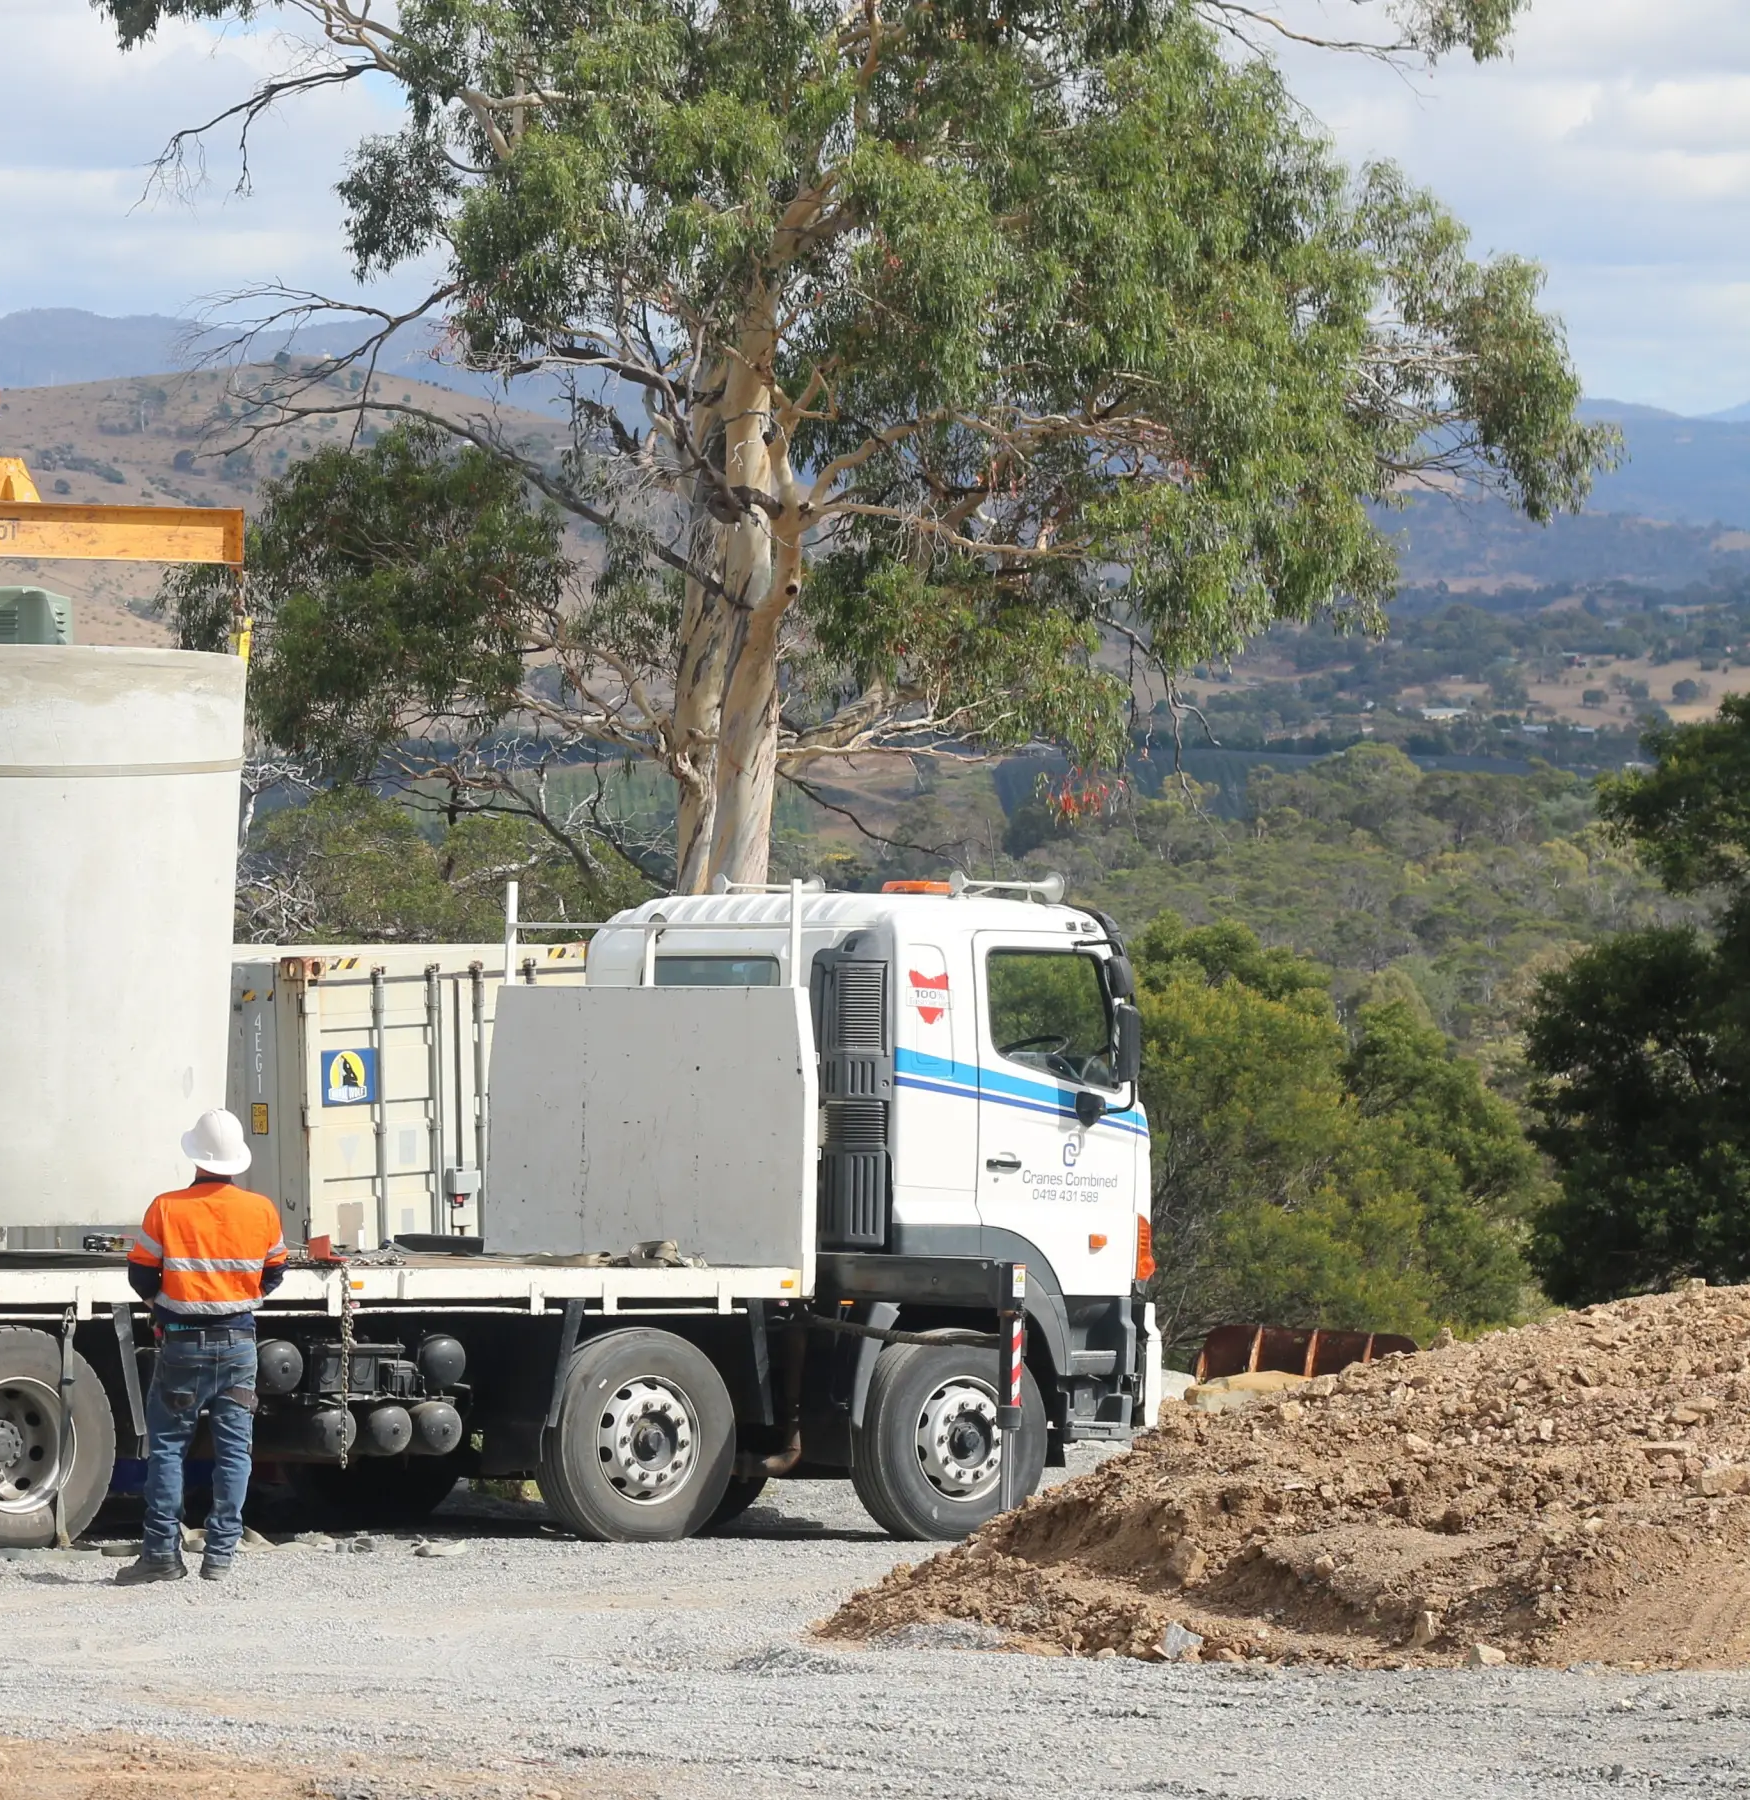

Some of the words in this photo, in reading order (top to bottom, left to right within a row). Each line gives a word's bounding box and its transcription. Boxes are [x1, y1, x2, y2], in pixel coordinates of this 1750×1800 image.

[1022, 1169, 1063, 1186] Cranes
[1065, 1171, 1118, 1189] Combined
[1032, 1188, 1057, 1201] 0419
[1059, 1190, 1078, 1202] 431
[1080, 1191, 1099, 1203] 589
